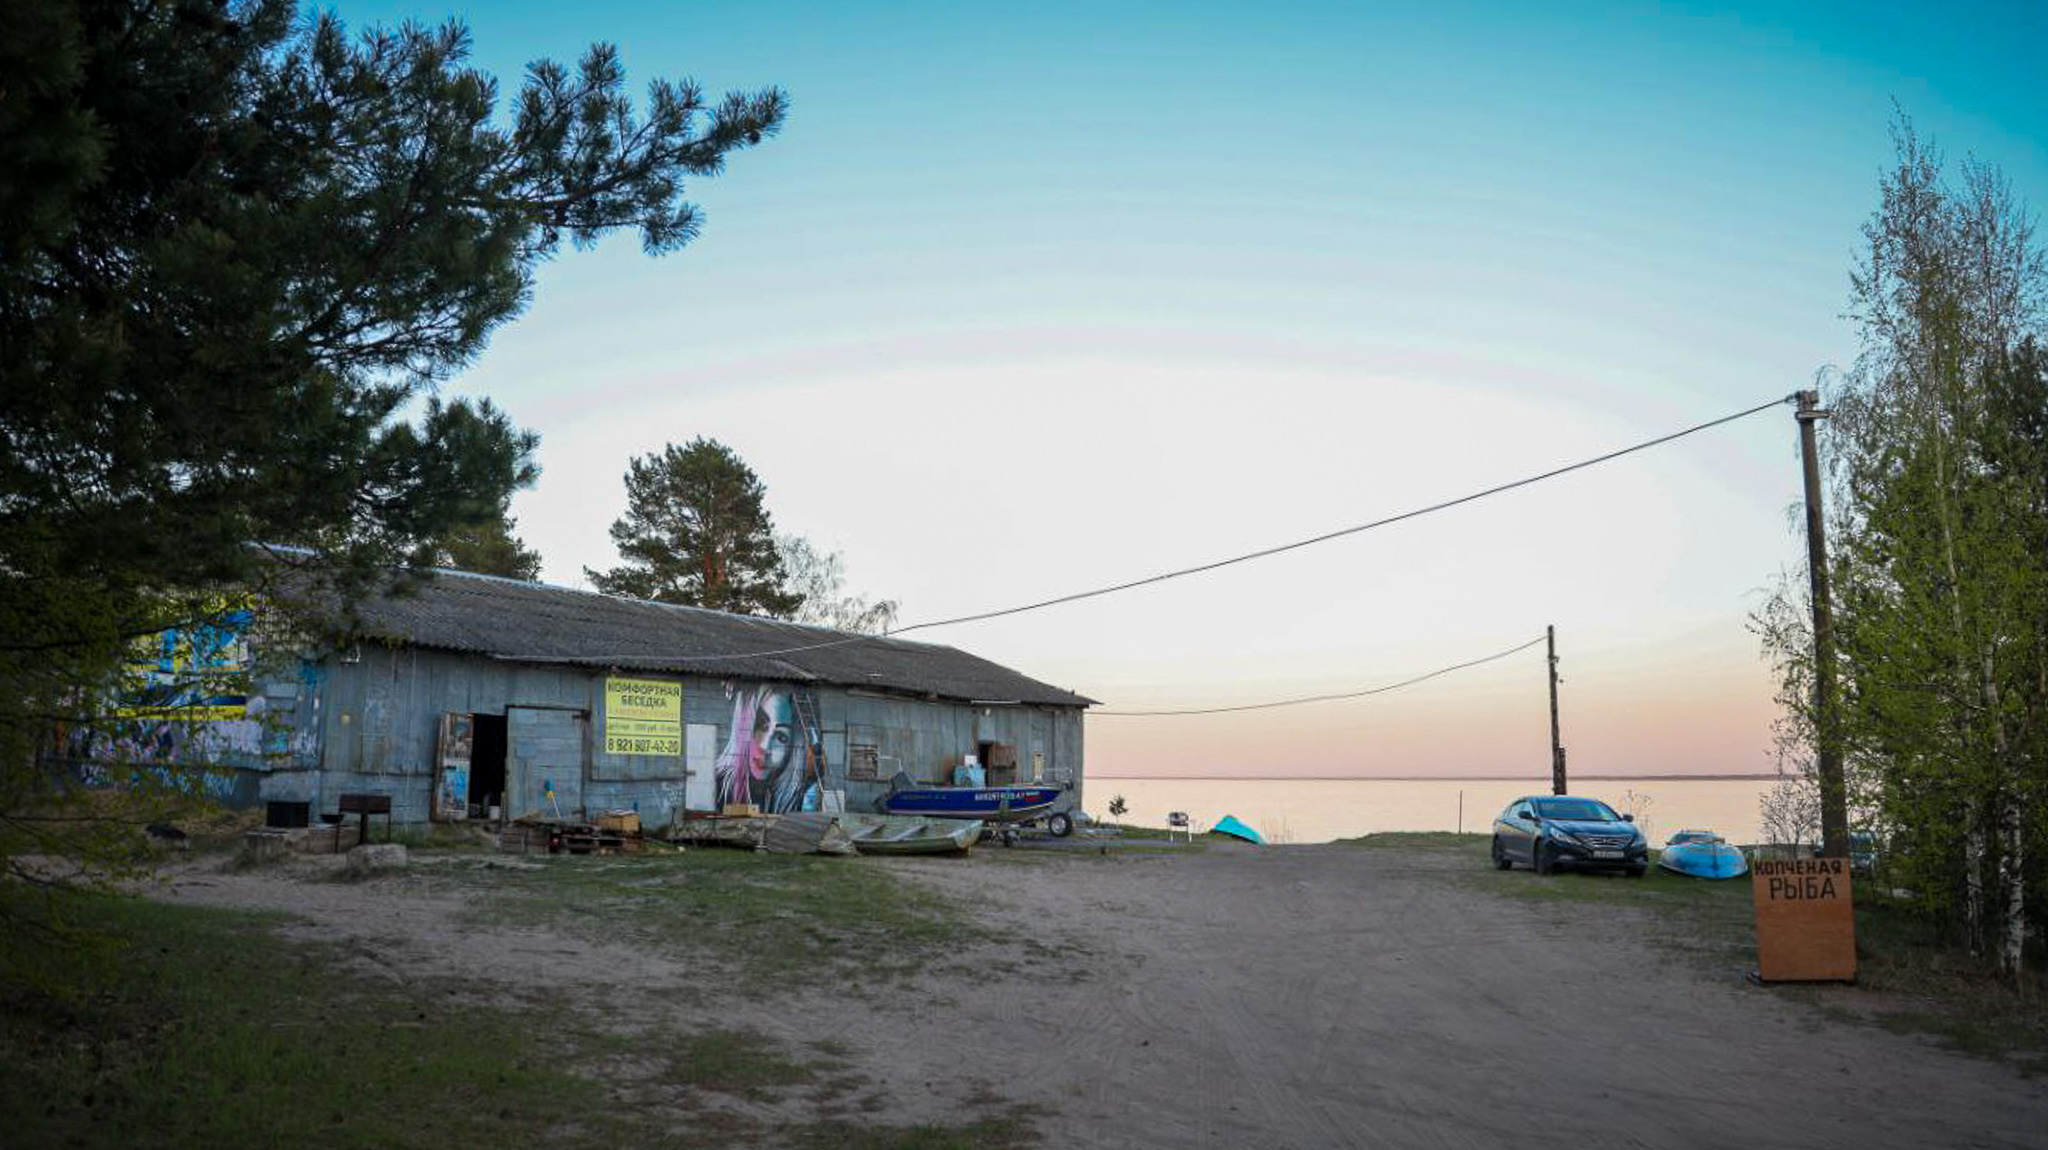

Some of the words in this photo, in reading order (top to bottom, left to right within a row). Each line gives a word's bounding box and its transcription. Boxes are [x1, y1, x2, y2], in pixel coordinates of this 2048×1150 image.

[608, 682, 680, 697] КОМФОРТНАЯ
[621, 695, 667, 709] БЕСЕДКА
[608, 738, 614, 751] 8
[616, 739, 632, 752] 921
[1754, 860, 1842, 875] КОПЧЕНАЯ
[1769, 877, 1837, 900] РЫБА
